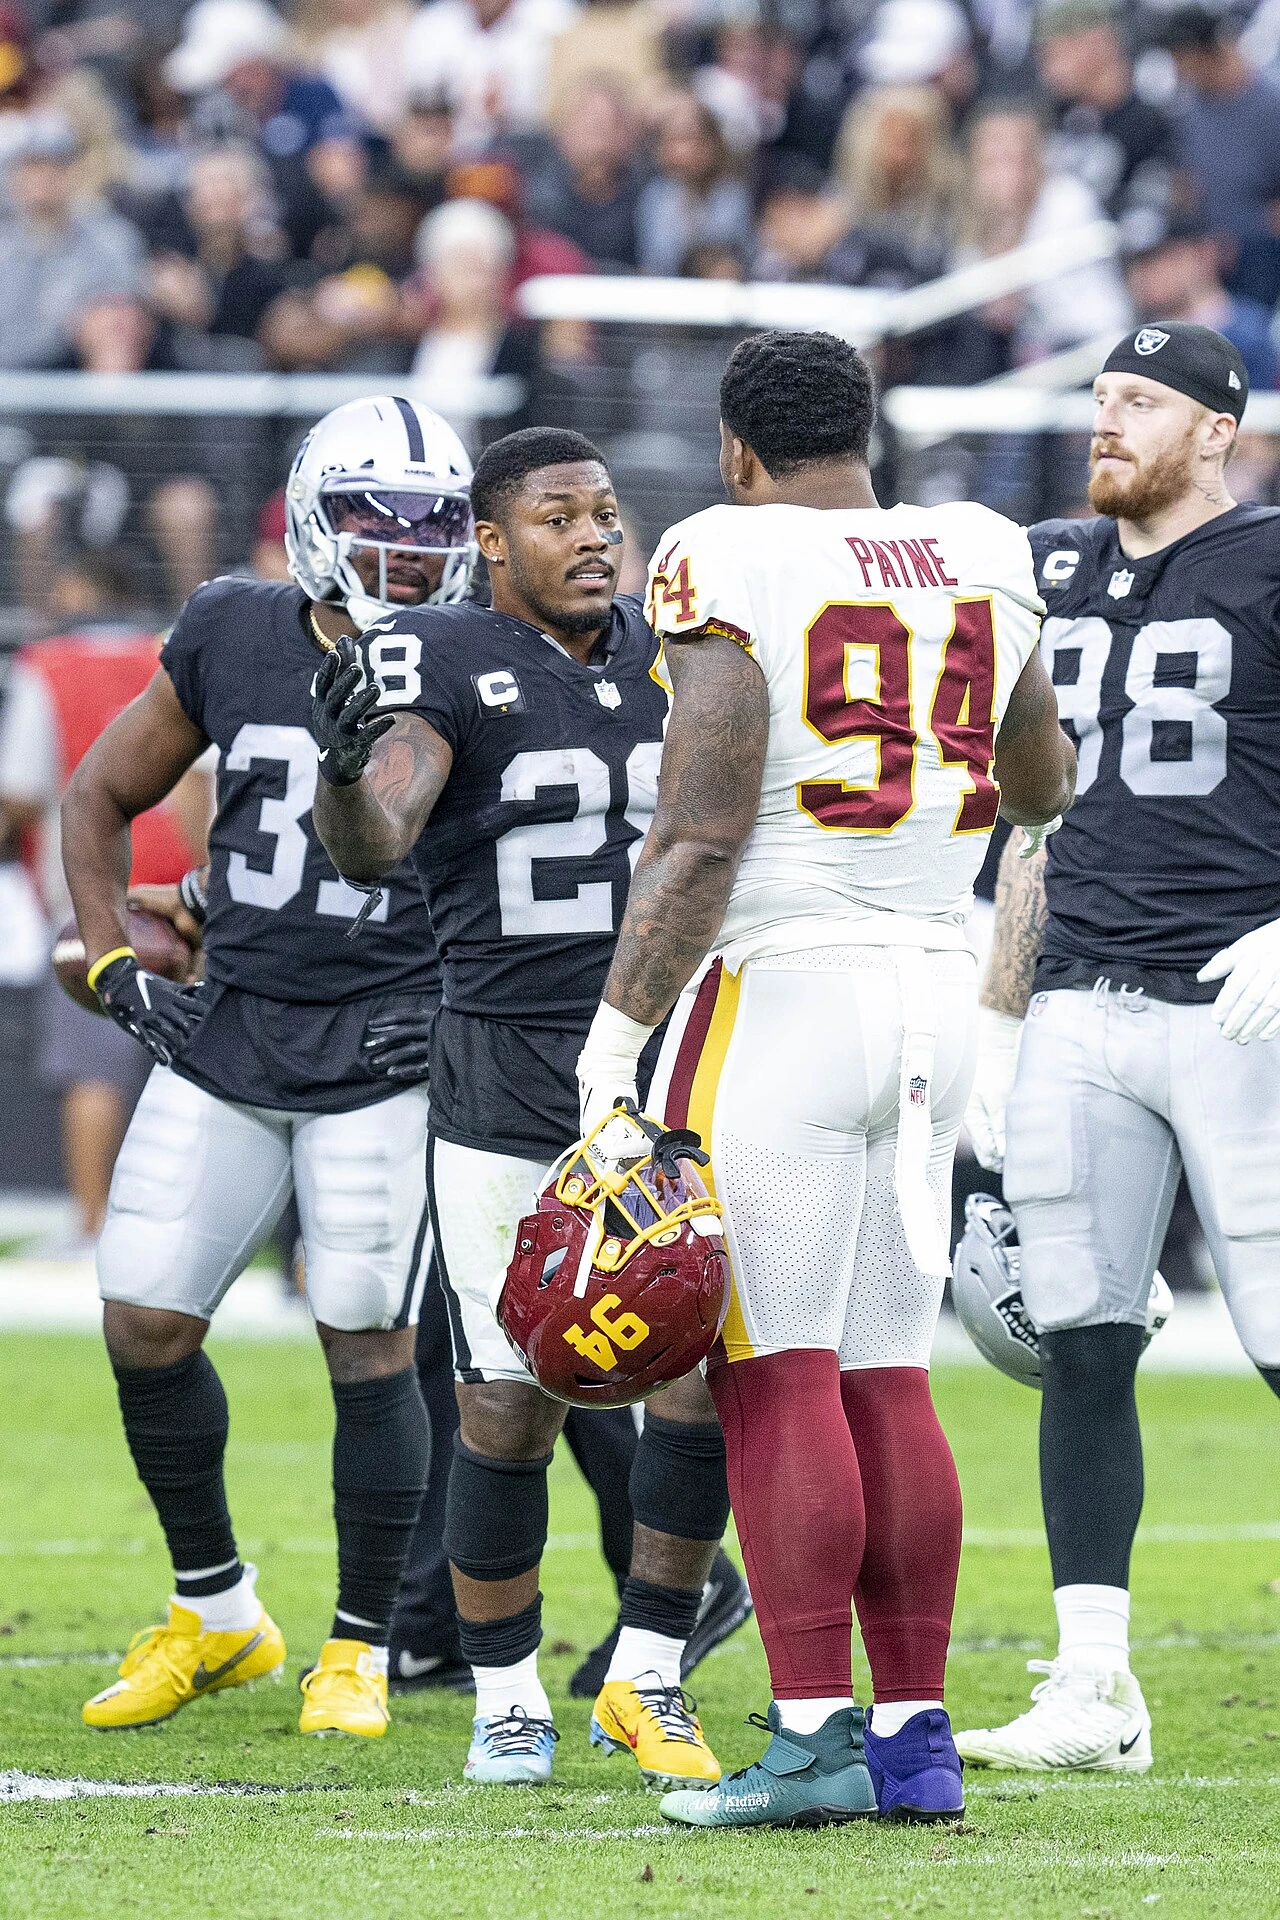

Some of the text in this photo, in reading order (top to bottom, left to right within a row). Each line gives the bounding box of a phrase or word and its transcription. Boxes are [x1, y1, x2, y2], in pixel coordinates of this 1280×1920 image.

[844, 537, 958, 588] PAYNE
[1042, 550, 1080, 580] C
[310, 634, 422, 706] 8
[477, 670, 519, 707] C
[796, 594, 1002, 836] 94
[910, 1089, 925, 1104] NFL
[562, 1293, 650, 1372] 94
[725, 1795, 770, 1808] Kidney
